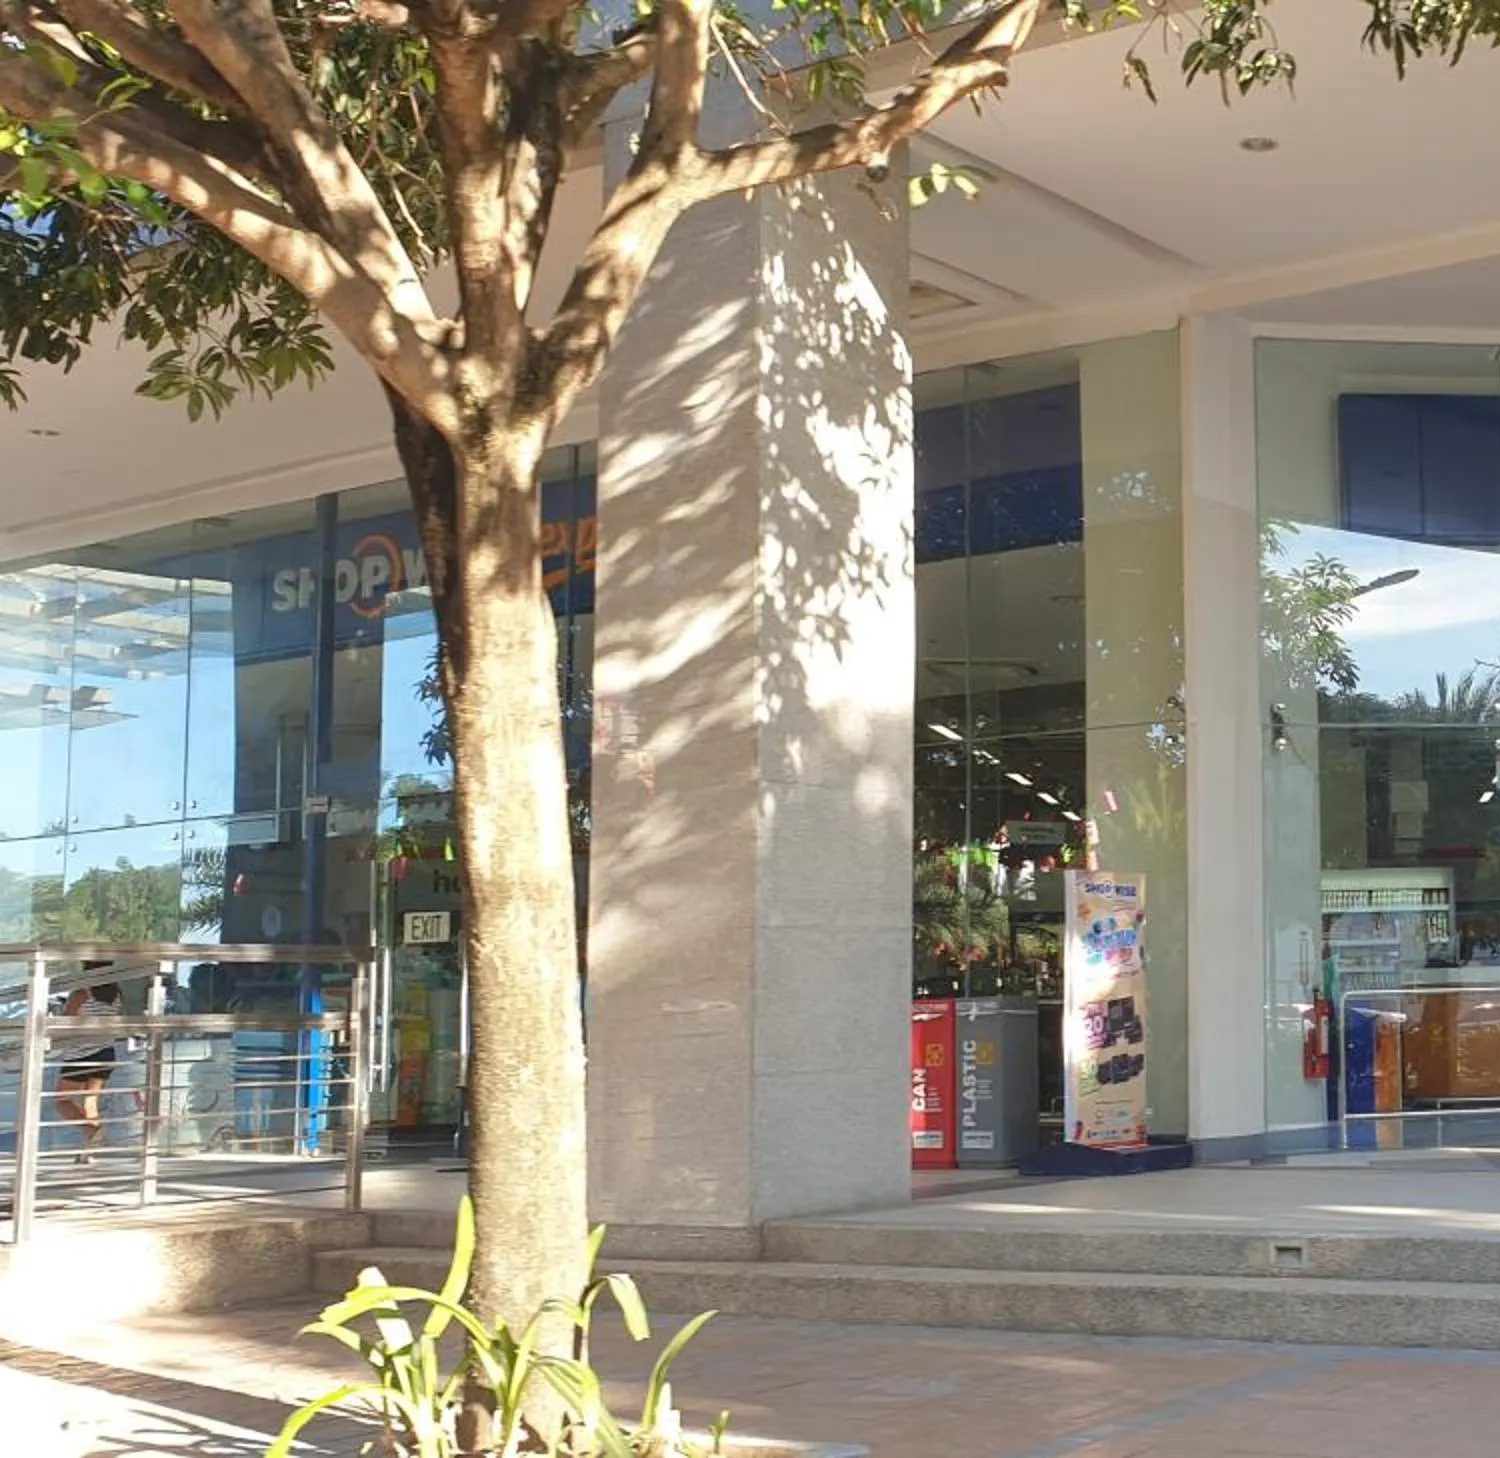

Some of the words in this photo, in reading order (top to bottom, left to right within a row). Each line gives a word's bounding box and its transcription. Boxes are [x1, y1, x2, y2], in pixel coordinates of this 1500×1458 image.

[411, 915, 441, 940] EXIT
[912, 1068, 927, 1112] CAN
[962, 1039, 977, 1127] PLASTIC
